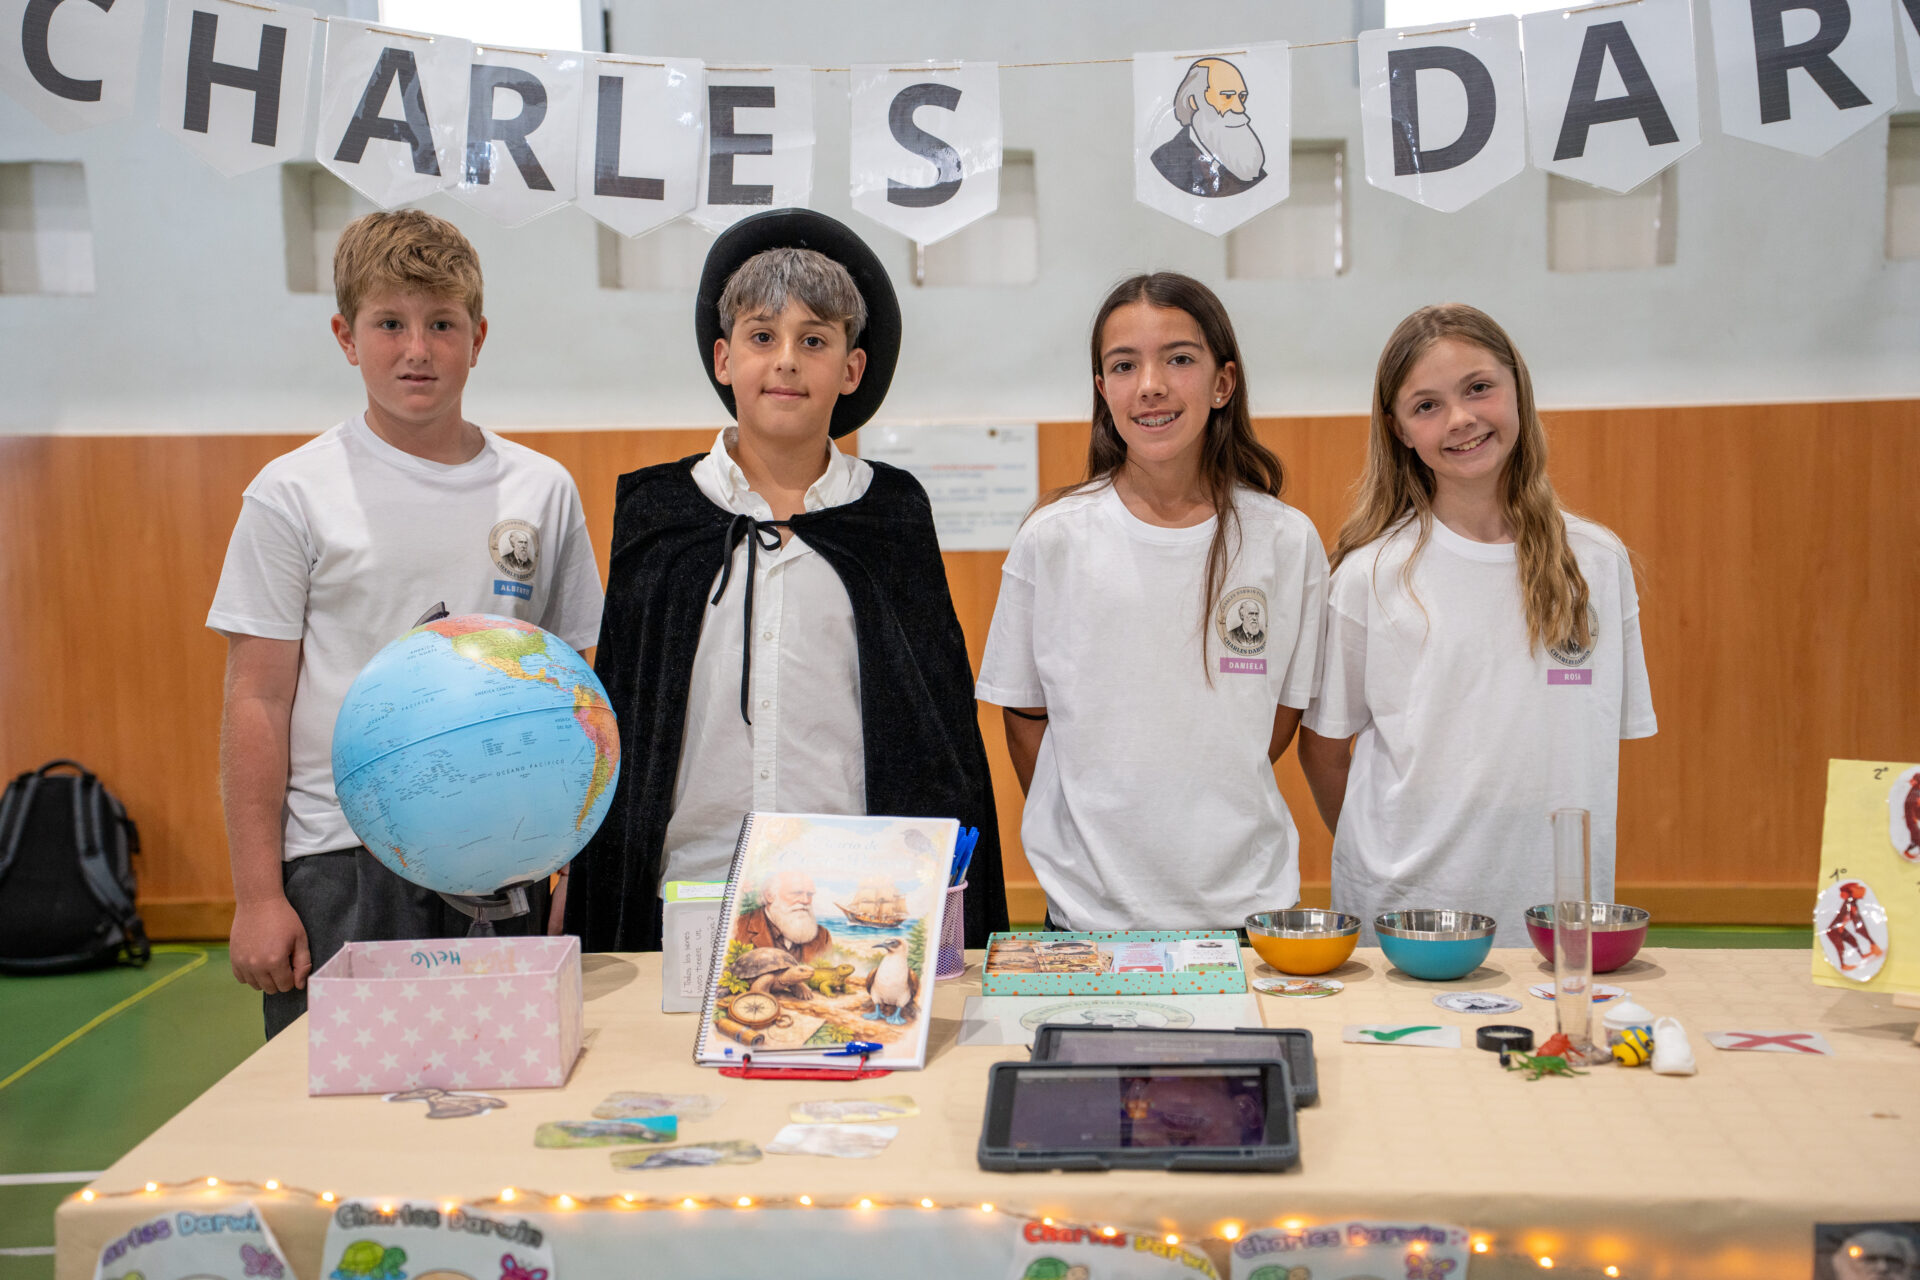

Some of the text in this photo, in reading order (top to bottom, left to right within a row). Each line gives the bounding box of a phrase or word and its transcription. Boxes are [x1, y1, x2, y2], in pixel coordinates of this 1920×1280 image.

[21, 0, 1920, 208] CHARLES DAR
[501, 584, 530, 595] ALBERTO
[1224, 636, 1247, 654] CHARLES
[1551, 648, 1574, 664] CHARLES
[1228, 661, 1264, 671] DANIELA
[410, 951, 461, 969] Hello
[336, 1201, 441, 1229] Charles
